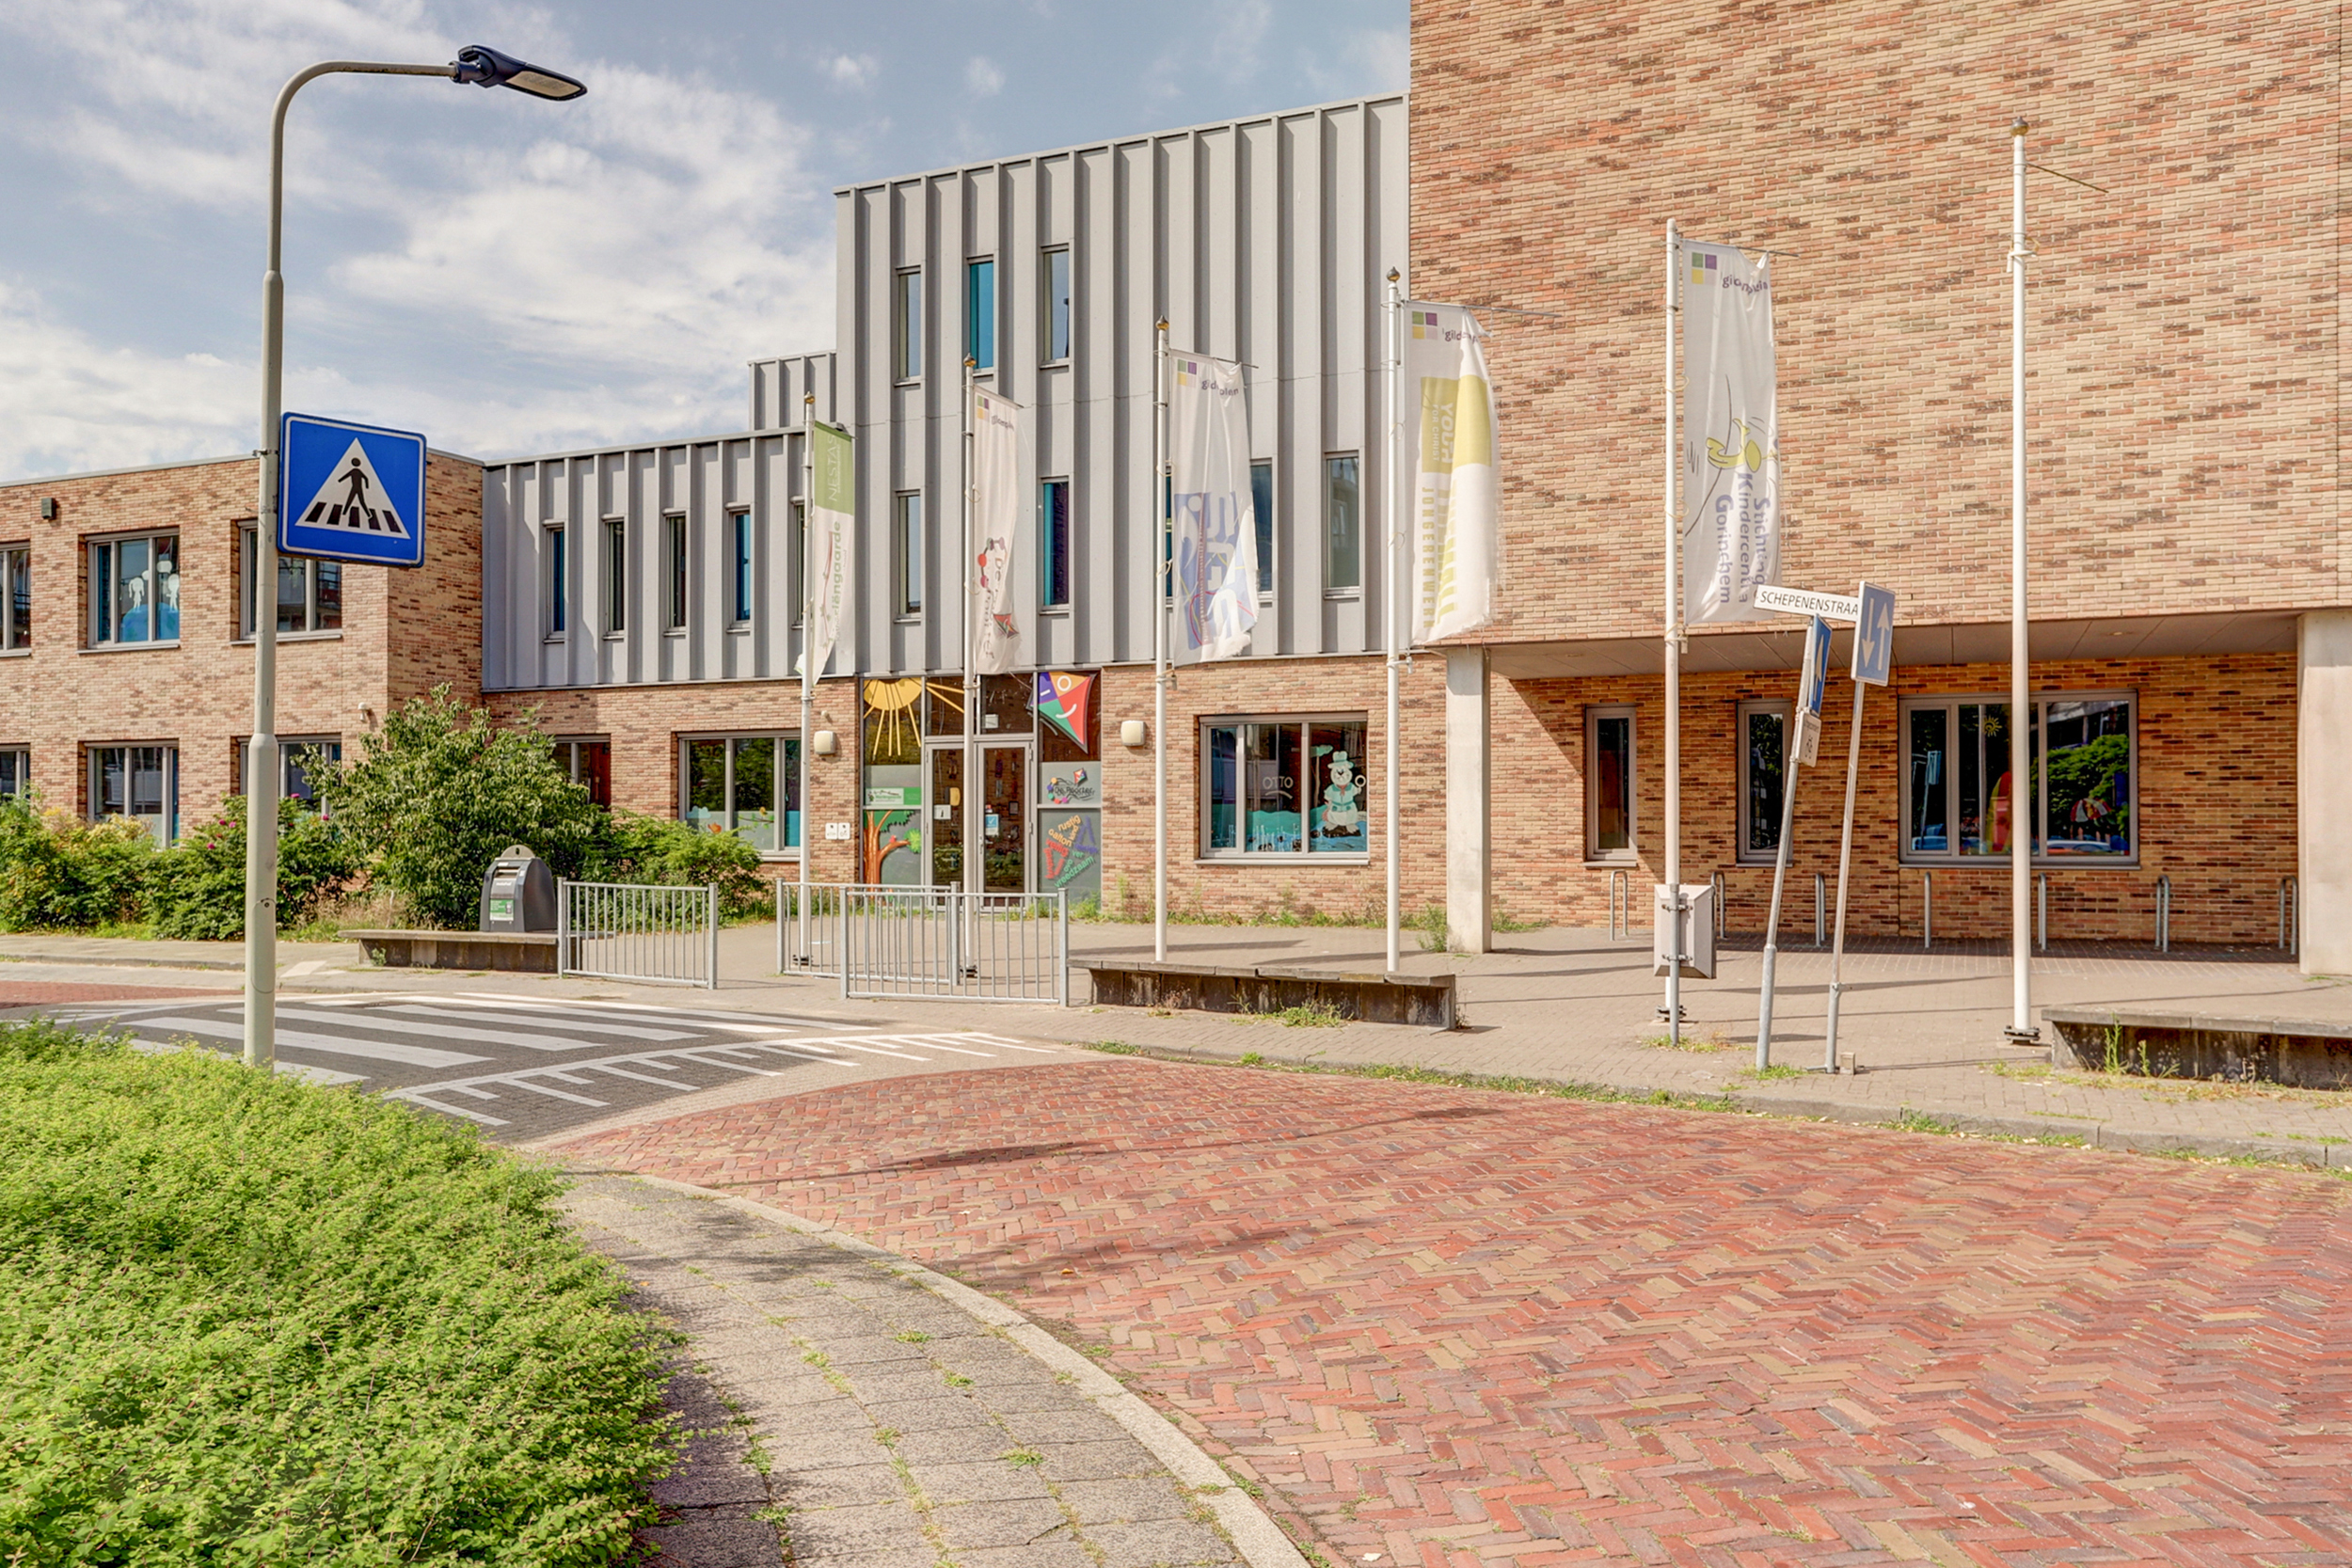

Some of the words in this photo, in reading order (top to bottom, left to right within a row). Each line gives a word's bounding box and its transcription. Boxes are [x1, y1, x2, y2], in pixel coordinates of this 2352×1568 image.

[1432, 426, 1440, 462] CHRIST
[1714, 494, 1735, 604] Gorinchem
[1738, 472, 1754, 603] Kindercenta
[1753, 498, 1772, 586] Stichting
[1760, 591, 1858, 616] SCHEPENENSTRAA
[1263, 776, 1294, 790] OTTO
